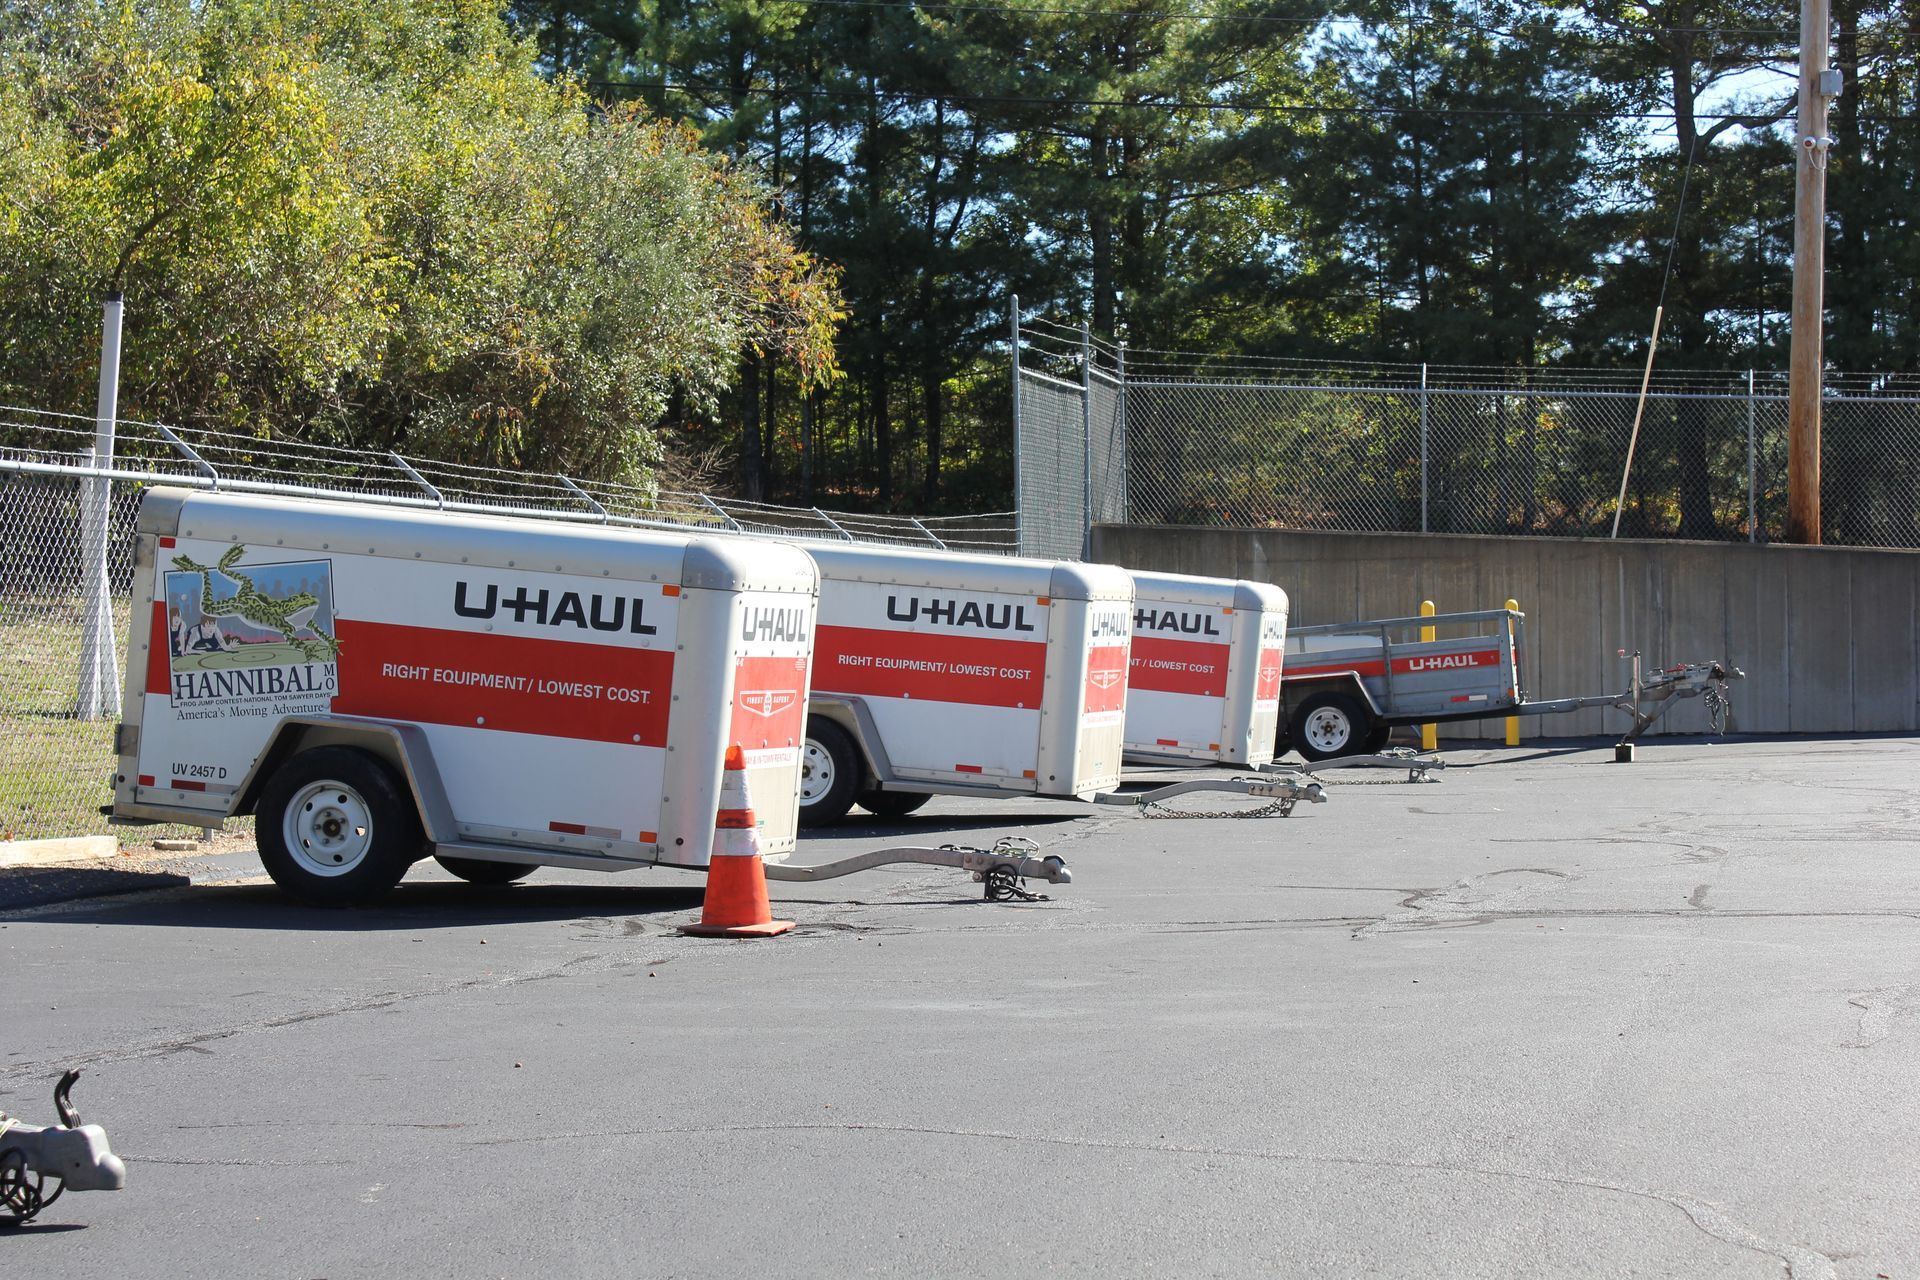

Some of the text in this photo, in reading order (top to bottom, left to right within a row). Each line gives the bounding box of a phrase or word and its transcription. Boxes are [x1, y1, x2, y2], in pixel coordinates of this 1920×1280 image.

[454, 582, 657, 636] U-HAUL
[887, 596, 1035, 632] U-HAUL
[743, 607, 806, 642] U-HAUL
[1092, 612, 1127, 637] U-HAUL
[1133, 608, 1220, 636] -HAUL
[838, 654, 873, 667] RIGHT
[949, 663, 999, 677] LOWEST
[1149, 659, 1187, 671] LOWEST
[1409, 655, 1479, 671] U-HAUL
[174, 664, 323, 700] HANNIBAL
[382, 663, 430, 682] RIGHT
[538, 679, 603, 699] LOWEST
[176, 702, 324, 721] America's Moving Adventure
[197, 699, 215, 707] JUMP
[288, 694, 313, 702] SAWYER
[172, 762, 227, 779] UV 2457 D
